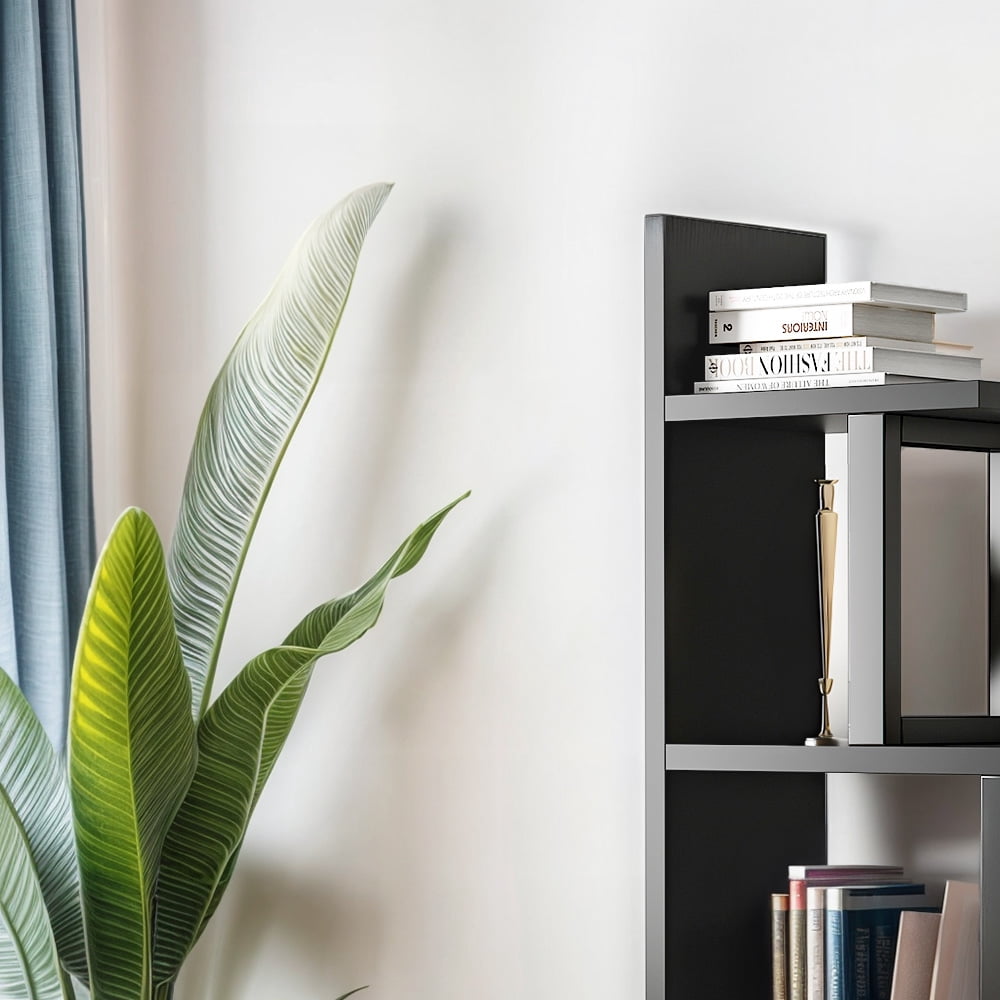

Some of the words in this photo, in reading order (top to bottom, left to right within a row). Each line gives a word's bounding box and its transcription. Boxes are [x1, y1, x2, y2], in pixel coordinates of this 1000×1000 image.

[722, 323, 733, 332] 2
[782, 321, 828, 334] INTERIORS
[759, 352, 830, 376] FASHION
[835, 350, 871, 372] THE
[813, 378, 829, 388] THE
